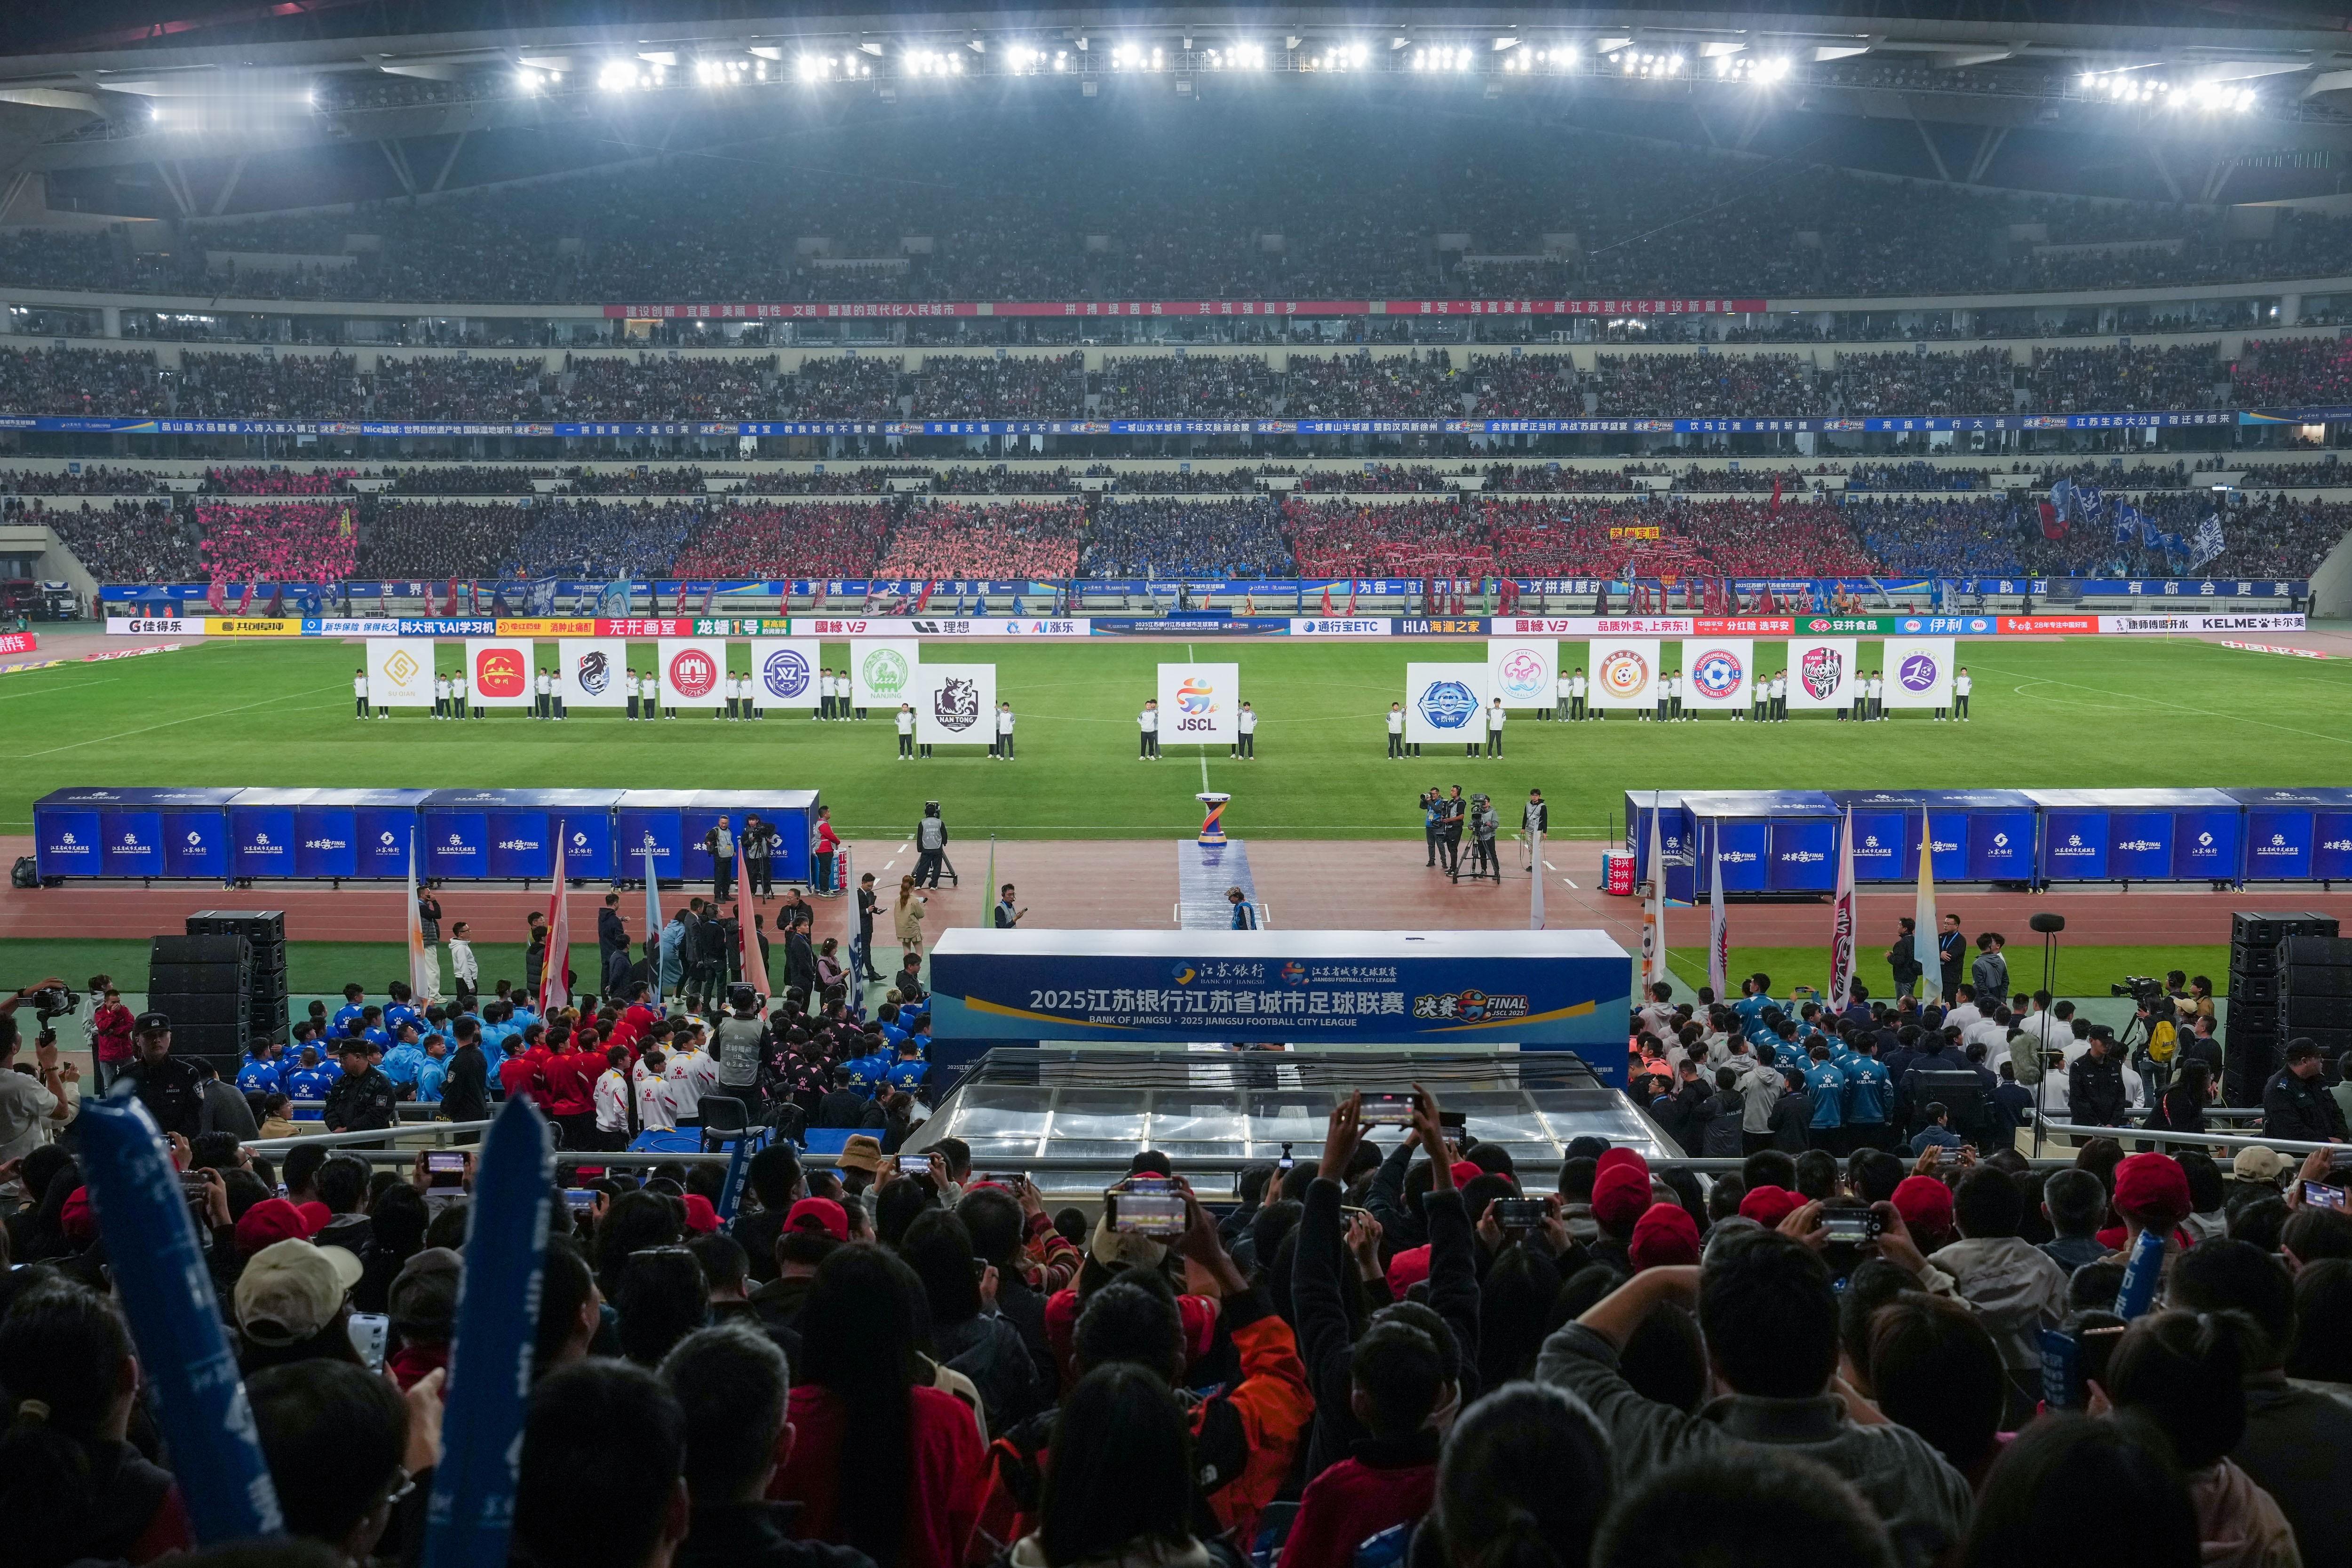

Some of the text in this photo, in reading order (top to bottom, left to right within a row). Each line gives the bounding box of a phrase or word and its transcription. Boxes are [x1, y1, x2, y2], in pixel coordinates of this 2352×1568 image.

[627, 304, 954, 318] 建设创新 宜居 美丽 韧性 文明 智慧的现代化人民城市
[1065, 302, 1297, 315] 拼搏绿茵场 共筑强国梦
[1690, 422, 1807, 430] 饮马江淮 披荆斩棘
[1883, 420, 2005, 429] 来扬州 行大运
[2076, 414, 2230, 427] 江苏生态大公园 宿迁等您来
[243, 423, 317, 433] 入诗入画入镇江
[404, 425, 461, 434] 世界自然遗产地
[463, 425, 512, 435] 国际湿地城市
[566, 425, 689, 434] 一拼到底 大圣归来
[784, 425, 876, 433] 教我如何不想她
[1118, 423, 1250, 432] 一城山水半城诗 千年文脉润金陵
[1305, 423, 1438, 432] 一城青山半城湖 楚韵汉风新徐州
[2128, 581, 2289, 596] 有你会更美
[143, 621, 183, 632] 佳得乐
[323, 622, 397, 631] 新华保险 保得长久
[400, 621, 494, 635] 科大讯飞AI学习机
[550, 622, 592, 633] 消肿止痛酊
[609, 620, 676, 635] 无形画室
[815, 621, 842, 633] 國緣
[943, 621, 969, 633] 理想
[1318, 621, 1378, 633] 通行宝ETC
[1516, 620, 1544, 632] 國緣
[1727, 621, 1756, 631] 分红险
[1759, 621, 1789, 631] 选平安
[1833, 620, 1877, 631] 安井食品
[1929, 618, 1963, 632] 伊利
[1973, 621, 1985, 629] Yili
[2129, 619, 2189, 629] 康师傅喝开水
[2202, 617, 2305, 629] KELME 卡尔美
[1697, 652, 1739, 669] LIANYUNGANG CITY
[679, 685, 709, 697] SUZHOU
[1697, 681, 1738, 697] FOOTBALL TEAM
[1177, 718, 1217, 731] JSCL
[306, 840, 320, 848] 决赛
[2119, 842, 2136, 850] 决赛
[1782, 853, 1798, 861] 决赛
[1200, 962, 1265, 979] 江苏银行
[1312, 966, 1398, 977] 江苏省城市足球联赛
[1030, 989, 1404, 1015] 2025江苏银行江苏省城市足球联赛
[1415, 995, 1526, 1018] 决赛 FINAL
[1089, 1015, 1357, 1027] BANK OF JIANGSU 2025 JIANGSU FOOTBALL CITY LEAGUE
[1726, 1108, 1743, 1117] KELME
